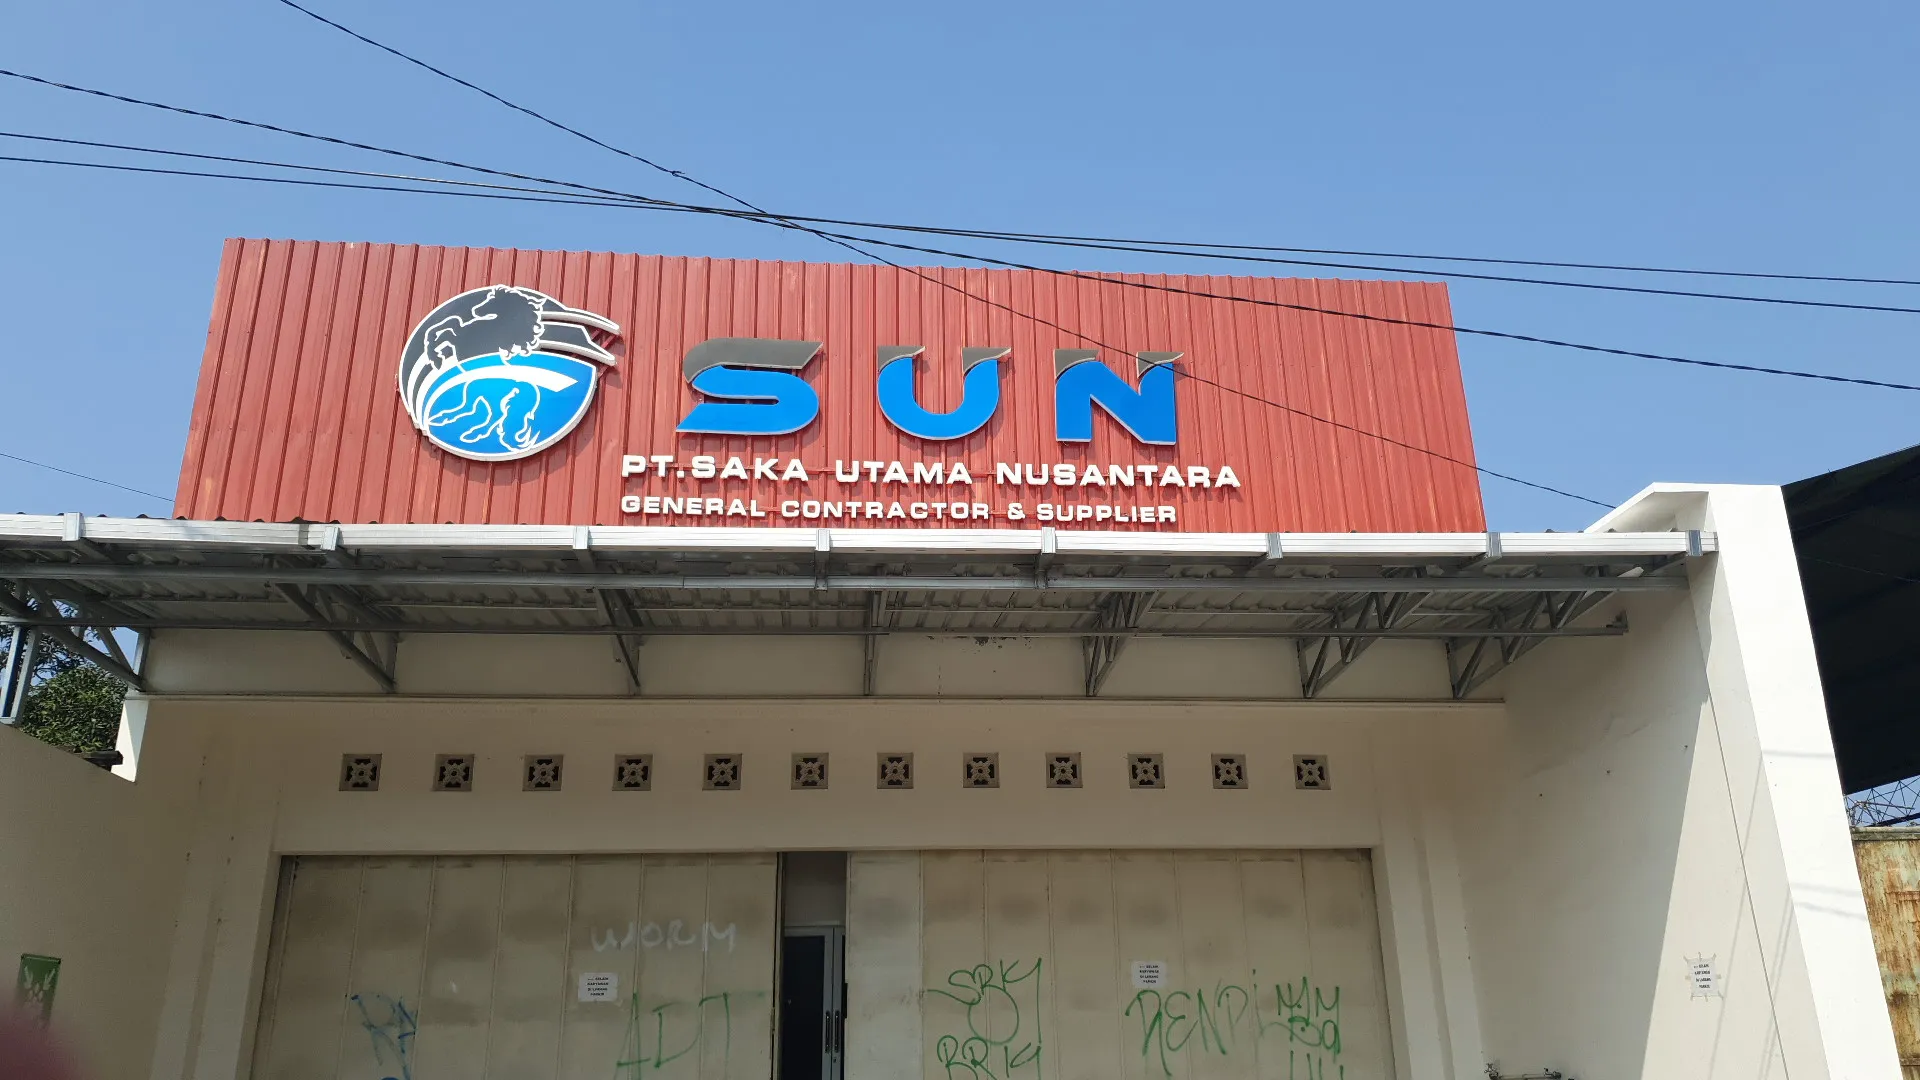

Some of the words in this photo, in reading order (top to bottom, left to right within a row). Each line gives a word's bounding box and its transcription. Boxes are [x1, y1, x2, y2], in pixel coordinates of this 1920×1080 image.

[676, 337, 1184, 446] SUN
[621, 454, 809, 482] PT.SAKA
[835, 459, 972, 485] UTAMA
[996, 462, 1242, 489] NUSANTARA
[621, 495, 766, 518] GENERAL
[781, 500, 989, 520] CONTRACTOR
[1007, 502, 1026, 521] &
[1036, 503, 1177, 523] SUPPLIER
